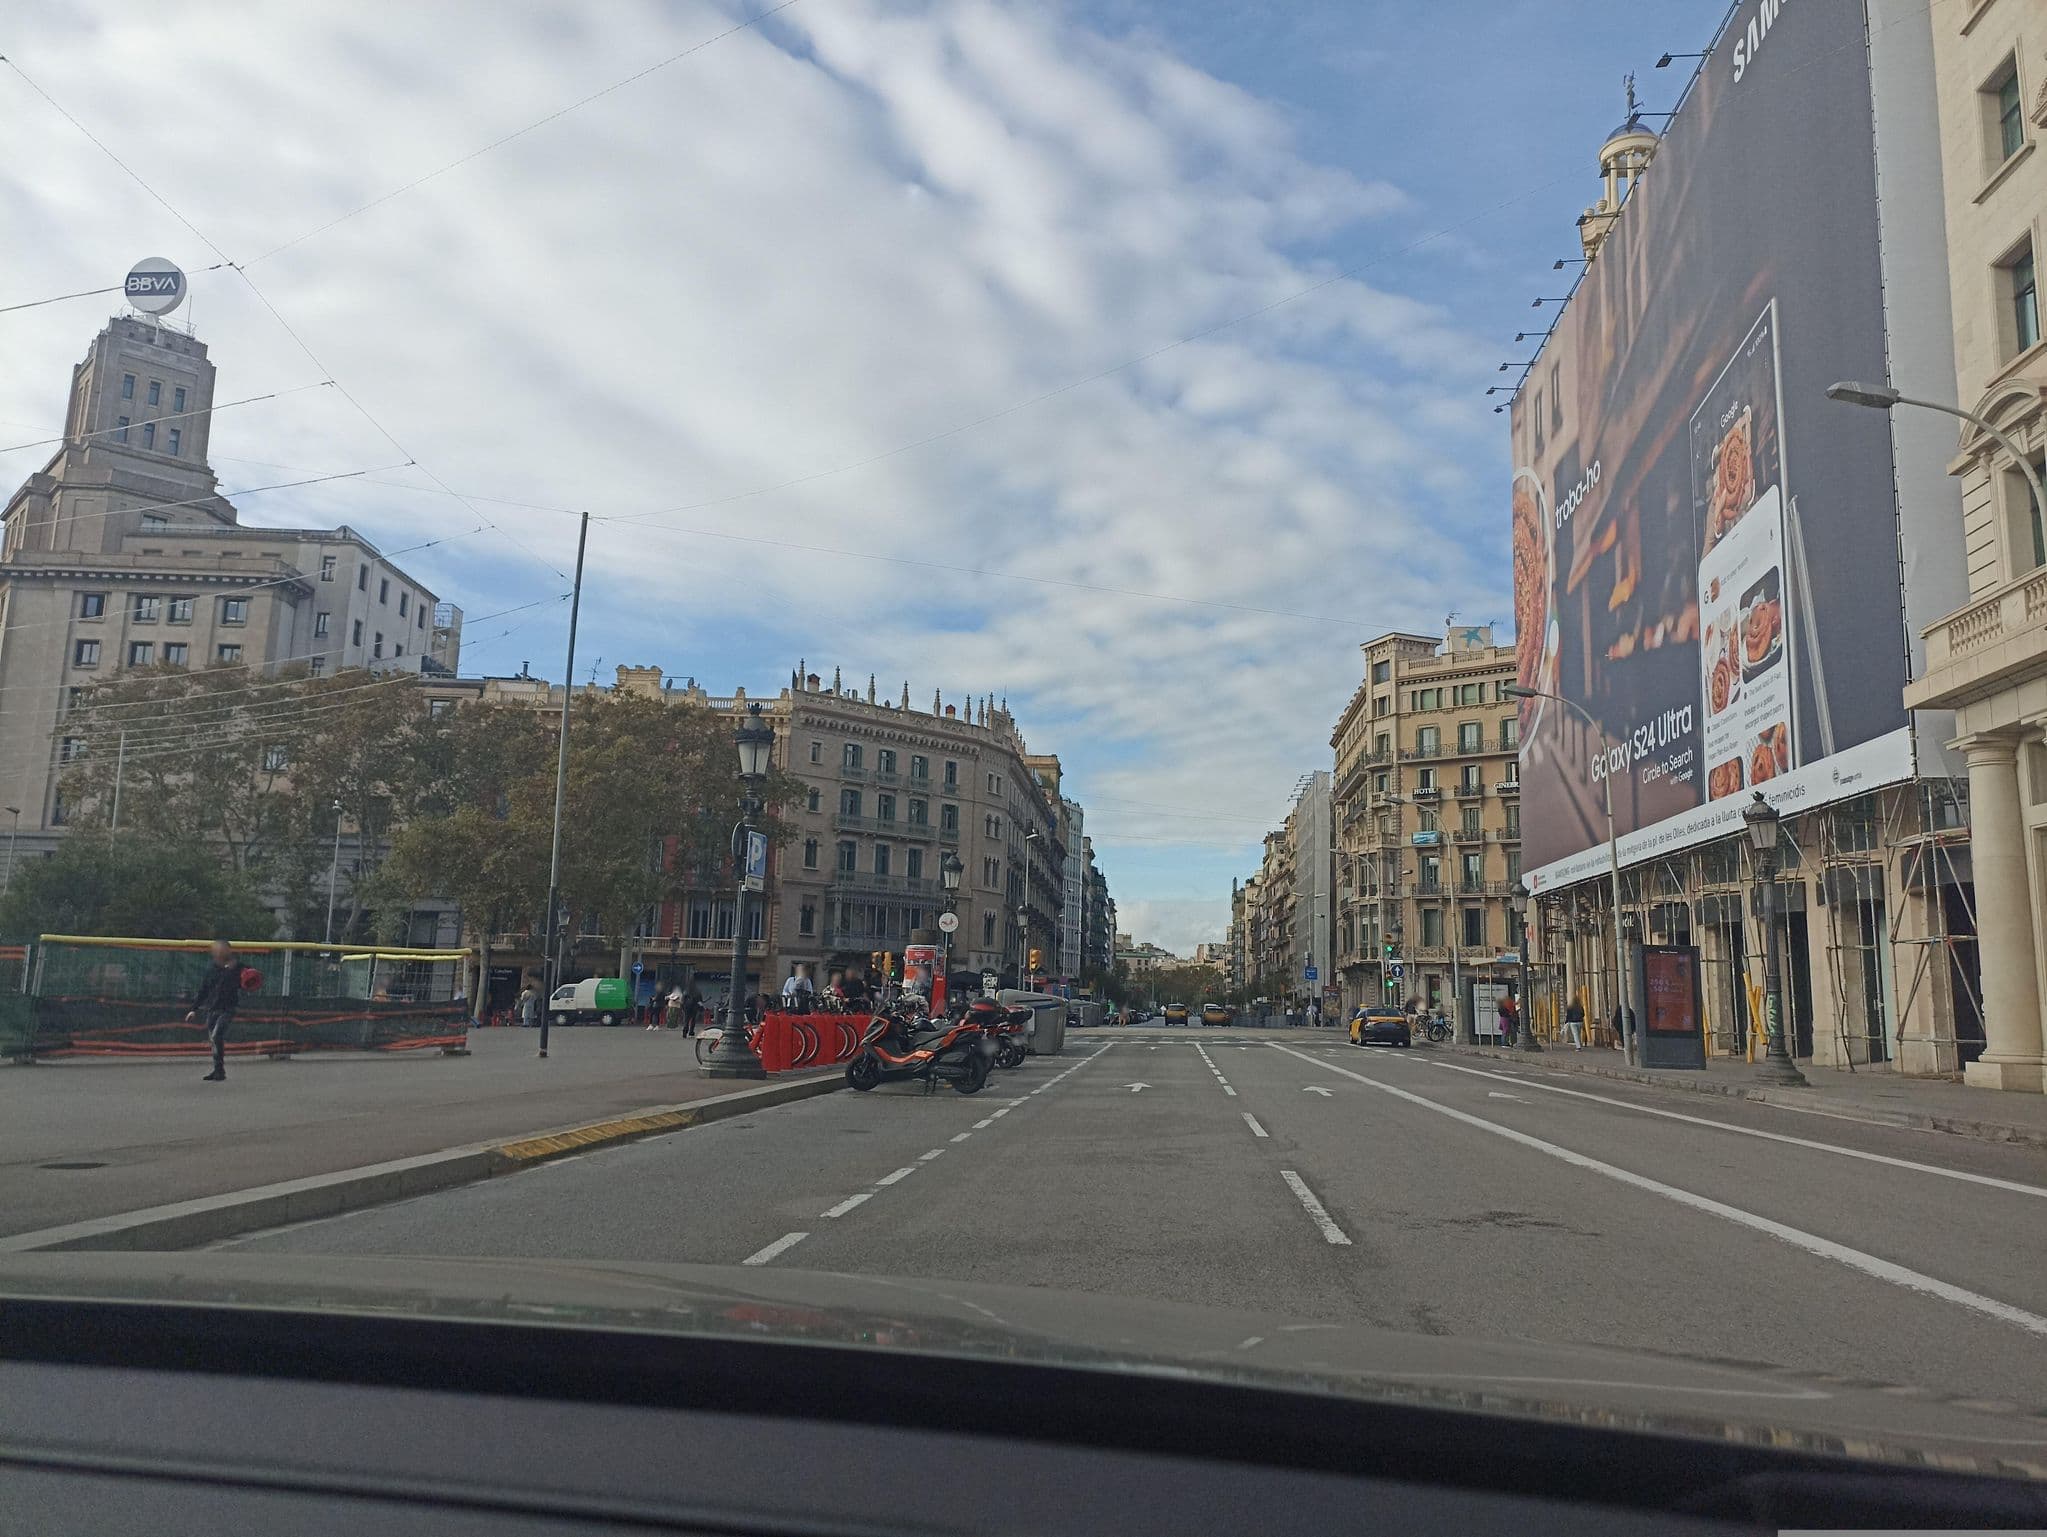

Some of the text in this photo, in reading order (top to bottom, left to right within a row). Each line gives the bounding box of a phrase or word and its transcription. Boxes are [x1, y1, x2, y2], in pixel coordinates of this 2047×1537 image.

[1734, 0, 1788, 83] SAM
[128, 277, 176, 291] BBVA
[1720, 400, 1738, 428] Google
[1555, 460, 1600, 530] troba-ho
[1591, 739, 1632, 783] Galaxy
[1633, 720, 1656, 760] S24
[1658, 704, 1692, 747] Ultra
[1642, 764, 1661, 784] Circle
[1661, 761, 1669, 775] to
[1669, 746, 1693, 771] Search
[1678, 769, 1693, 782] Google
[1687, 816, 1710, 835] dedicada
[1711, 817, 1715, 827] a
[1716, 812, 1721, 825] la
[1722, 809, 1737, 823] lluita
[1769, 784, 1805, 807] feminicidis
